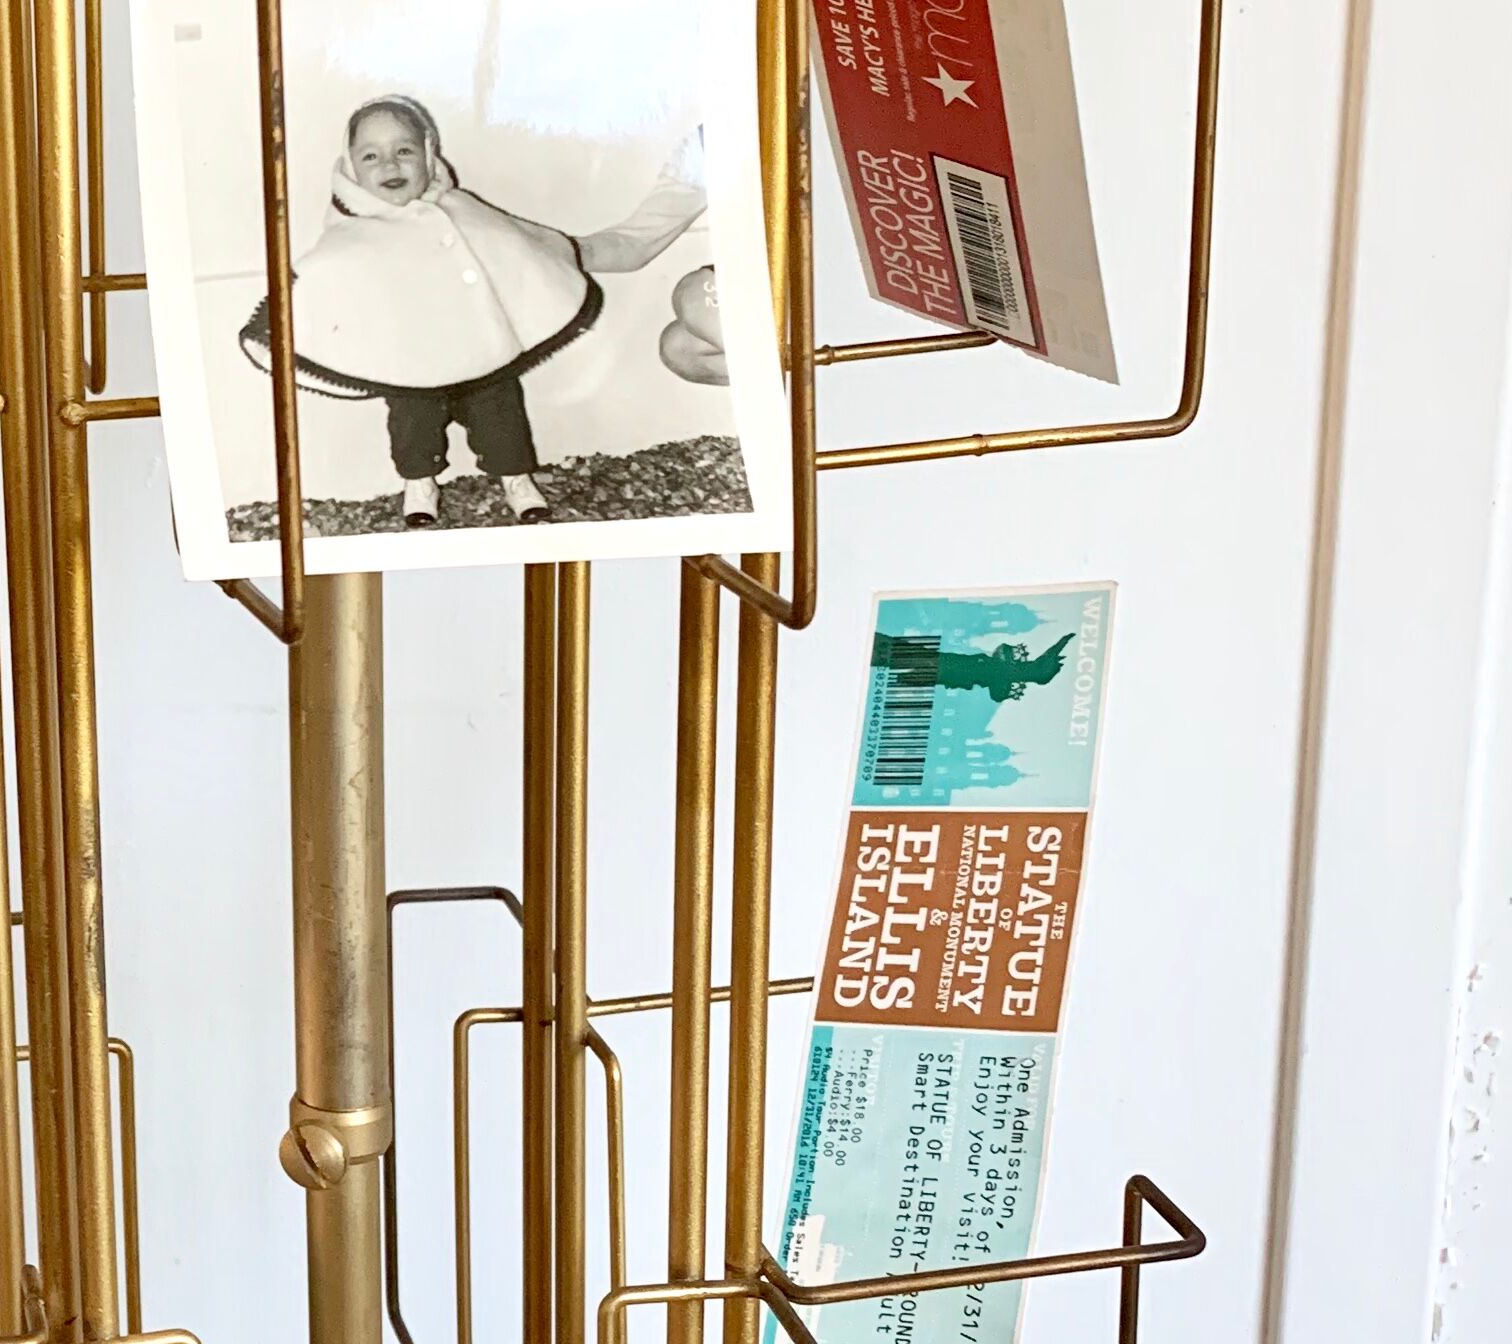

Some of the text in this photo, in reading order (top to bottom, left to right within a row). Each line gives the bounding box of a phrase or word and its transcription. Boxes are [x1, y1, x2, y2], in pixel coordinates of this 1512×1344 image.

[830, 18, 857, 70] SAVE
[859, 23, 890, 96] MACY'S
[856, 148, 919, 294] DISCOVER
[890, 148, 956, 314] THE MAGIC!
[1061, 594, 1107, 747] WELCOME!
[830, 823, 896, 1009] ISLAND
[866, 823, 941, 1012] ELLIS
[928, 908, 949, 926] &
[934, 824, 976, 1013] NATIONAL MONUMENT
[950, 824, 1009, 1015] LIBERTY
[997, 907, 1014, 931] OF
[999, 825, 1063, 1017] STATUE
[1049, 901, 1068, 940] THE
[818, 1063, 831, 1095] Audio
[857, 1048, 874, 1088] Price
[909, 1052, 935, 1111] Smart
[927, 1053, 956, 1125] STATUE
[989, 1055, 1020, 1130] Within
[813, 1100, 826, 1124] Tour
[806, 1129, 822, 1173] Portion
[924, 1138, 944, 1162] OF
[951, 1055, 998, 1262] Enjoy your visit!
[988, 1142, 1007, 1155] 3
[994, 1057, 1037, 1230] One Admission,
[798, 1178, 815, 1227] Includes
[888, 1125, 927, 1259] Destination
[976, 1167, 1004, 1217] days
[781, 1231, 795, 1263] Order
[791, 1232, 805, 1263] Sales
[973, 1230, 994, 1253] of
